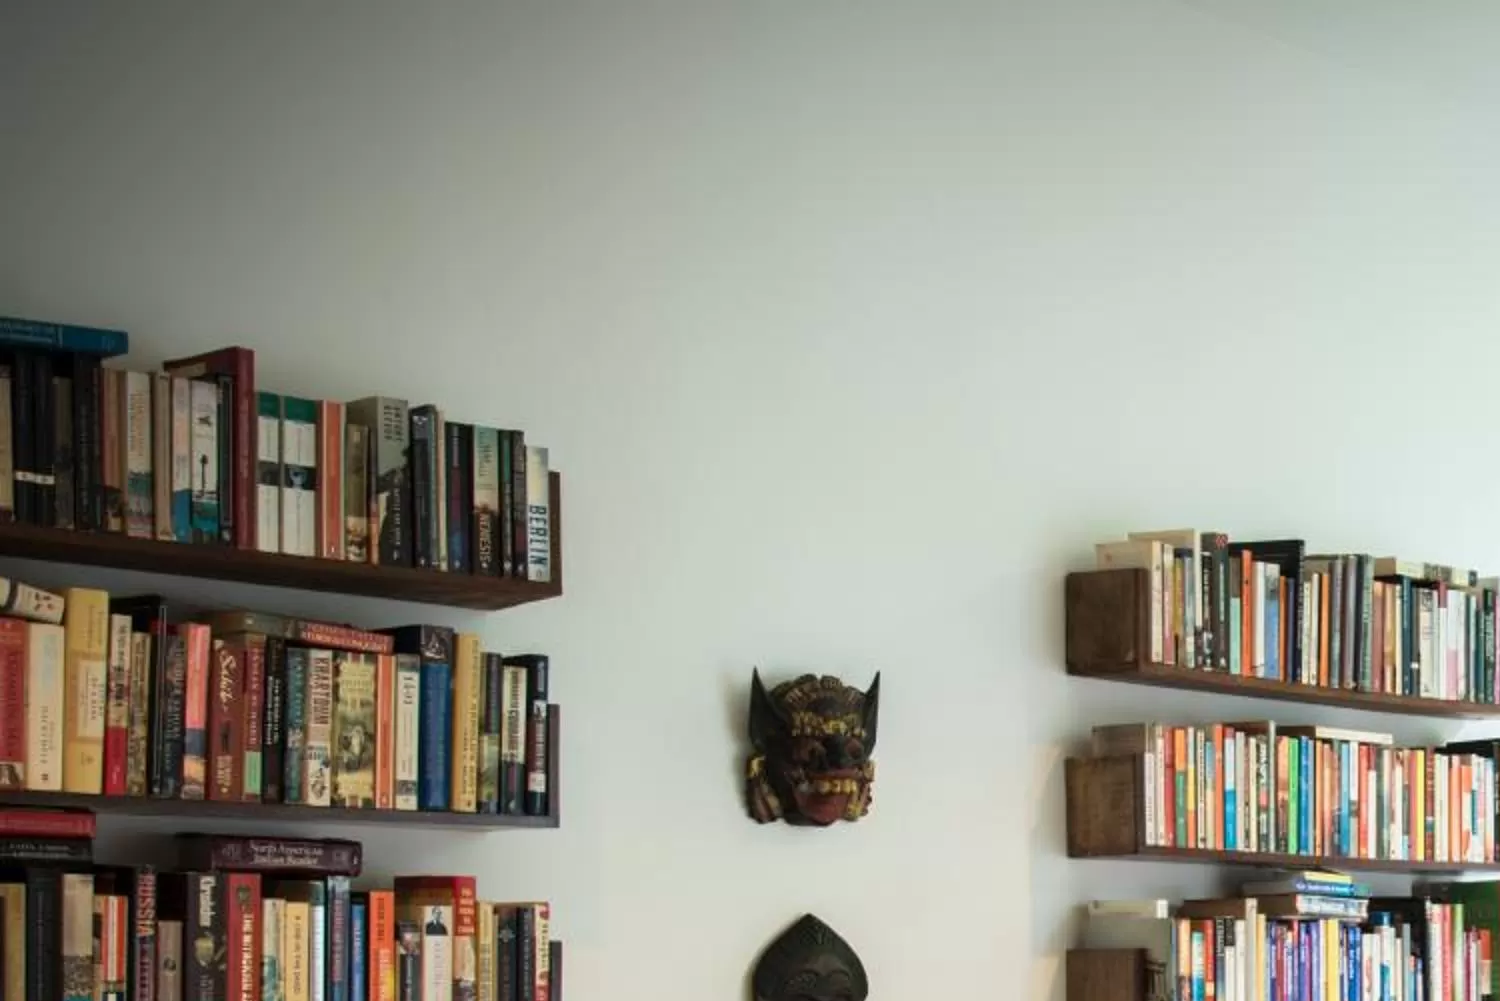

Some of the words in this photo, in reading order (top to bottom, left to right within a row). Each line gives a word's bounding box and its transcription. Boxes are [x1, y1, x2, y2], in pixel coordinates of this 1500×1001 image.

[529, 505, 549, 566] BERLIN
[312, 657, 331, 725] KHARTOUM
[137, 873, 155, 938] RUSSIA
